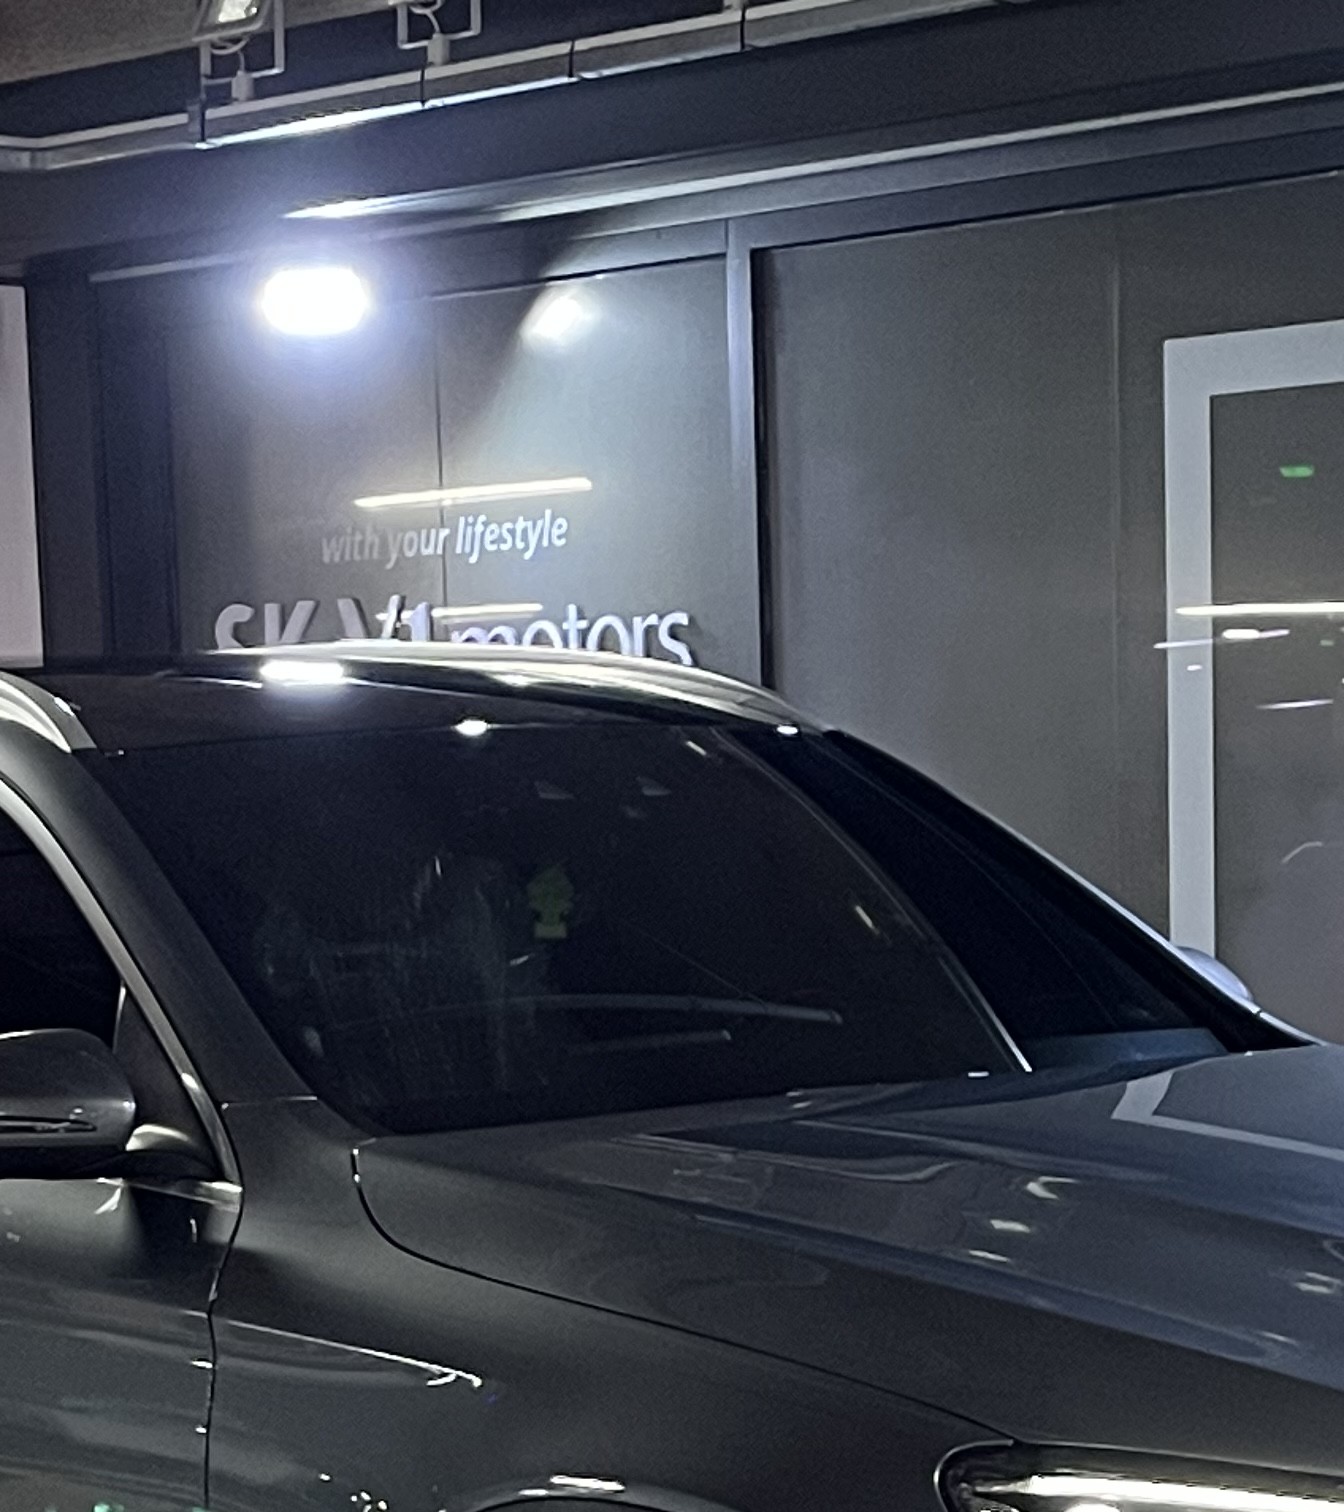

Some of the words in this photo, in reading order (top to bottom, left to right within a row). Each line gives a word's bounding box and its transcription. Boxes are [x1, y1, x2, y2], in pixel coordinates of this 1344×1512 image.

[321, 524, 380, 564] with
[385, 526, 450, 569] your
[455, 508, 569, 564] lifestyle
[450, 603, 693, 666] otors
